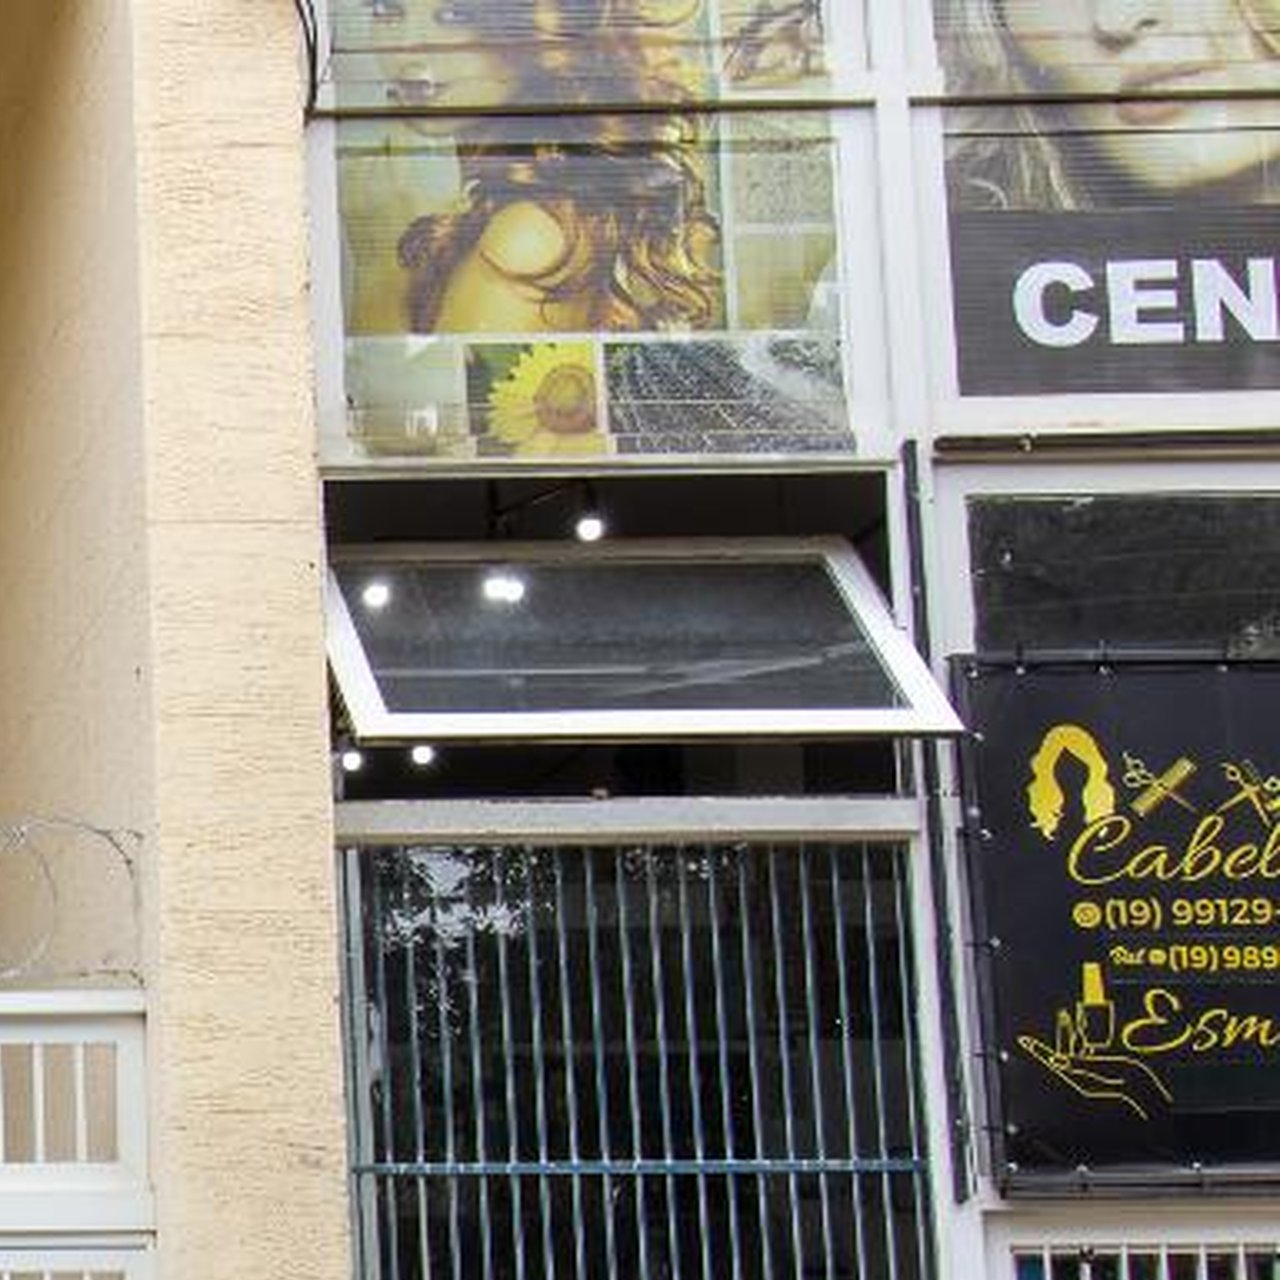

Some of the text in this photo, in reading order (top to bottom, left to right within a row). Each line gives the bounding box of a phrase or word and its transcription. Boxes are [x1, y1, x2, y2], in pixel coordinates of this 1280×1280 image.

[1013, 257, 1280, 348] CEN
[1105, 898, 1163, 931] (19)
[1169, 945, 1218, 972] (19)
